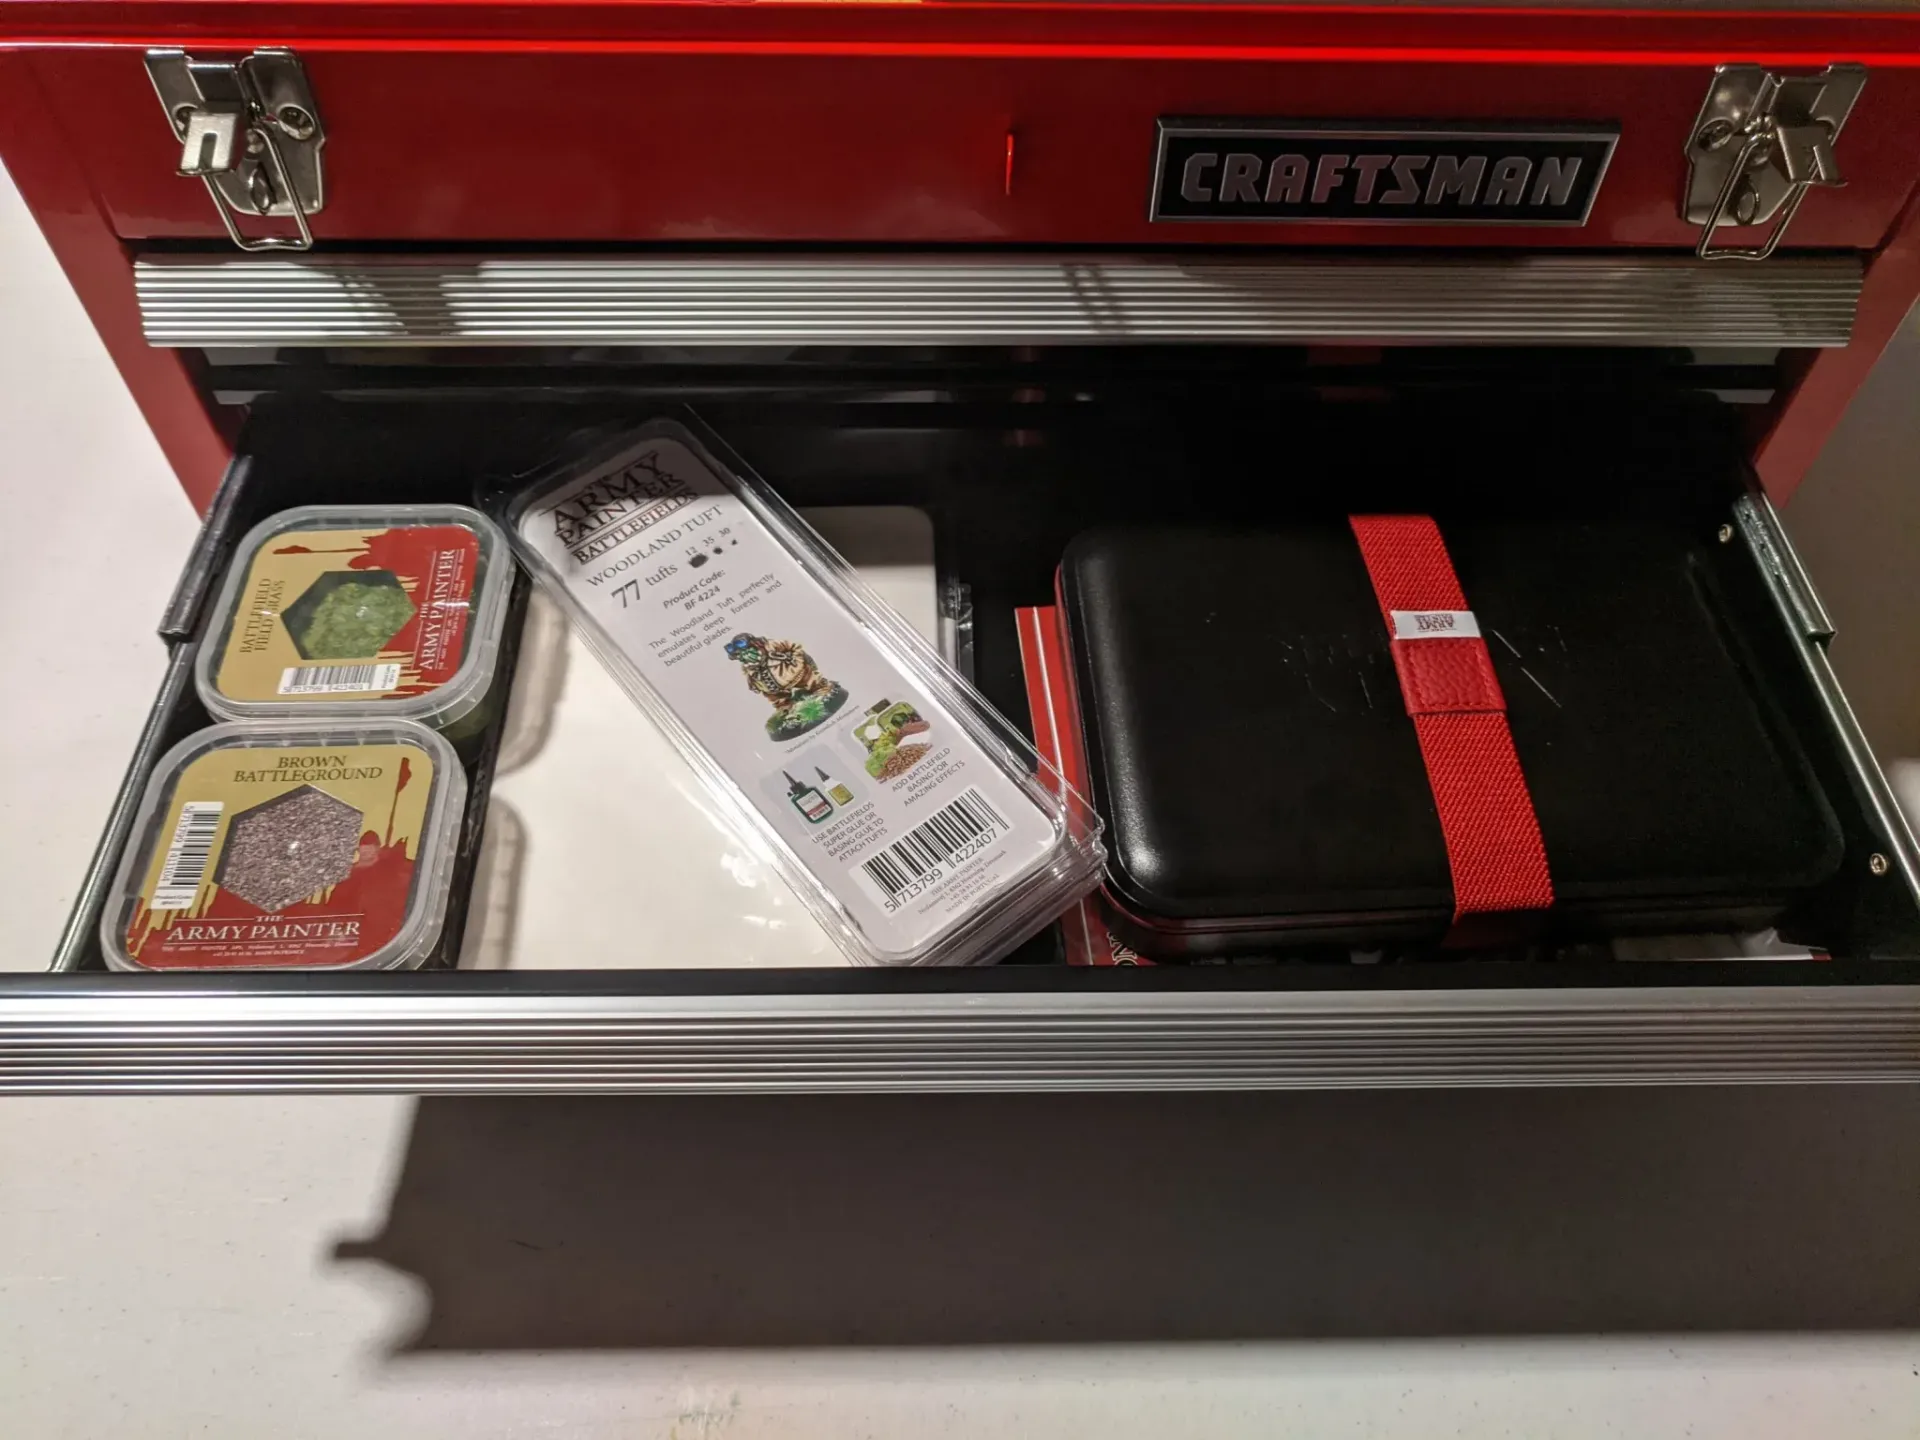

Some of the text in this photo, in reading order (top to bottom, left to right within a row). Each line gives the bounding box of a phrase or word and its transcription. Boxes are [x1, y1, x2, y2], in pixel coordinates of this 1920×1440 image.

[1180, 152, 1582, 205] CRAFTSMAN
[553, 452, 666, 533] ARMY
[555, 471, 685, 547] PAINTER
[573, 489, 699, 564] BATTLEFIELDS
[586, 503, 724, 588] WOODLAND TUFT
[429, 547, 455, 619] PAINTER
[610, 525, 731, 610] 77 tufts 12 35 30
[662, 567, 726, 610] Product Code:
[239, 577, 271, 652] BATTLEFIELD
[419, 601, 429, 619] THE
[648, 571, 776, 651] The Woodland Tuft perfectly
[656, 579, 782, 659] emulates deep forests and
[683, 584, 721, 611] BF 4224
[254, 618, 274, 649] FIELD
[419, 621, 440, 669] ARMY
[663, 622, 733, 668] beautiful glades.
[233, 766, 383, 783] BATTLEGROUND
[278, 755, 348, 769] BROWN
[890, 746, 951, 793] ADD BATTLEFIELD
[902, 759, 966, 806] AMAZING EFFECTS
[905, 759, 949, 792] BASING FOR
[811, 830, 828, 844] USE
[825, 800, 875, 835] BATTLEFIELDS
[822, 810, 876, 849] SUPER GLUE OR
[827, 816, 884, 857] BASING GLUE TO
[837, 826, 888, 862] ATTACH TUFTS
[883, 828, 998, 913] 5 713799 422407
[166, 921, 362, 941] ARMY PAINTER
[255, 914, 285, 922] THE
